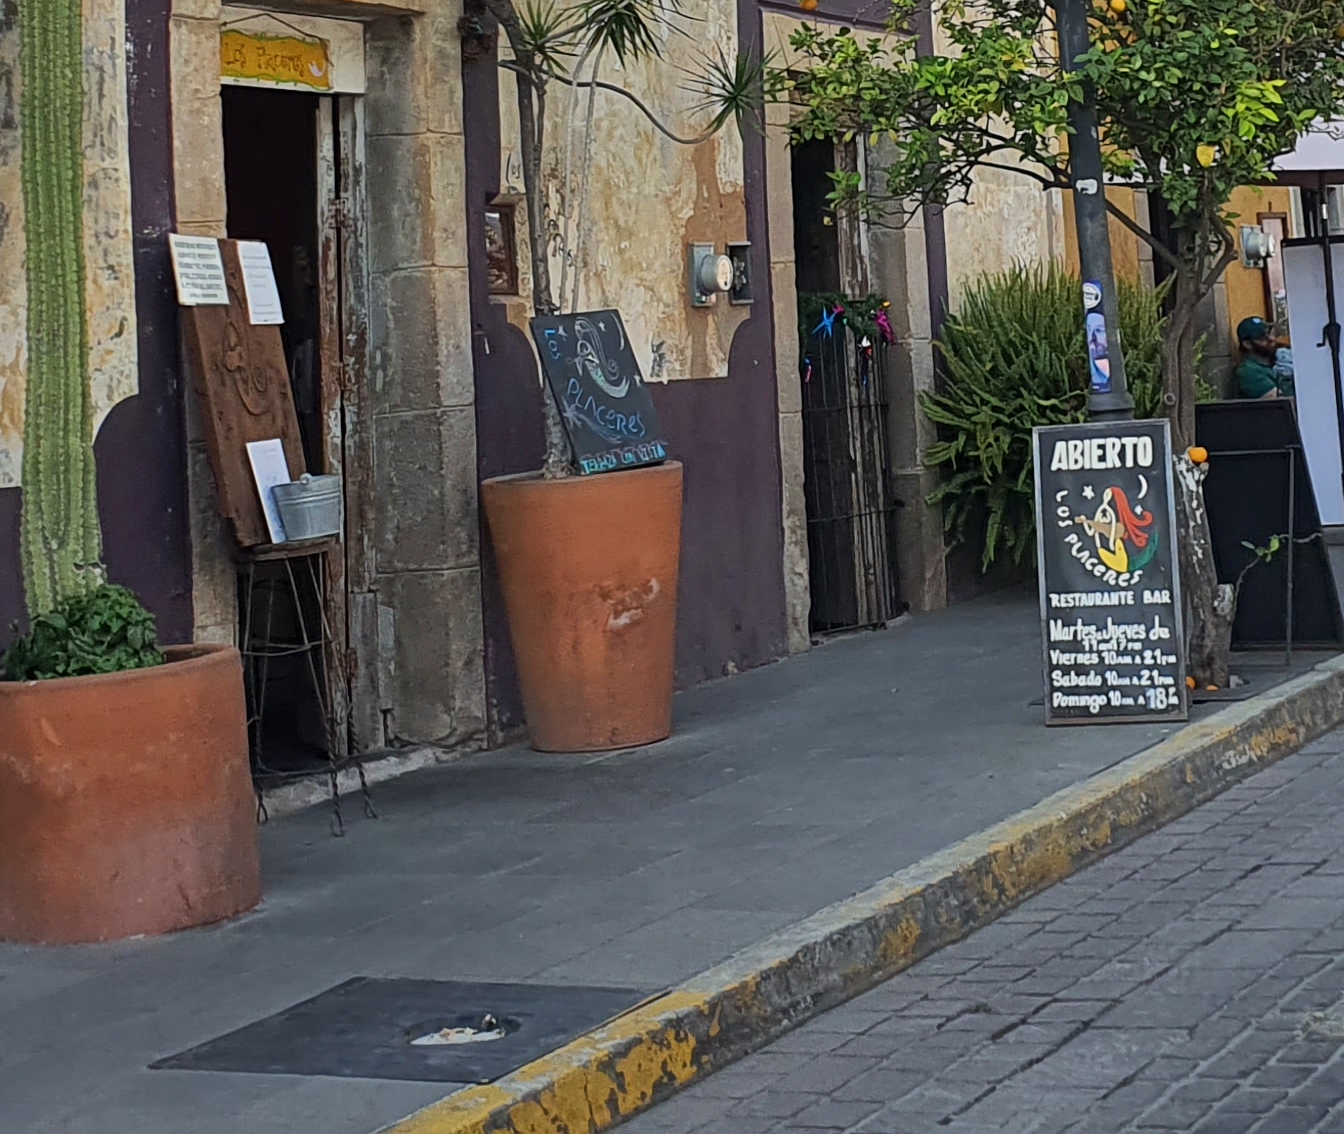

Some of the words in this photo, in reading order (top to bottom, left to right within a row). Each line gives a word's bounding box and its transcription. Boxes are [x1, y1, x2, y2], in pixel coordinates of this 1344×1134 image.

[1050, 436, 1153, 471] ABIERTO
[1056, 490, 1073, 527] LOS
[1049, 591, 1135, 608] RESTAURANTE
[1143, 589, 1172, 605] BAR
[1049, 618, 1096, 642] Martes
[1102, 616, 1146, 640] Jueves
[1148, 615, 1170, 641] de
[1049, 649, 1099, 665] Viernes
[1051, 670, 1102, 687] Sabado
[1052, 691, 1107, 714] Domingo
